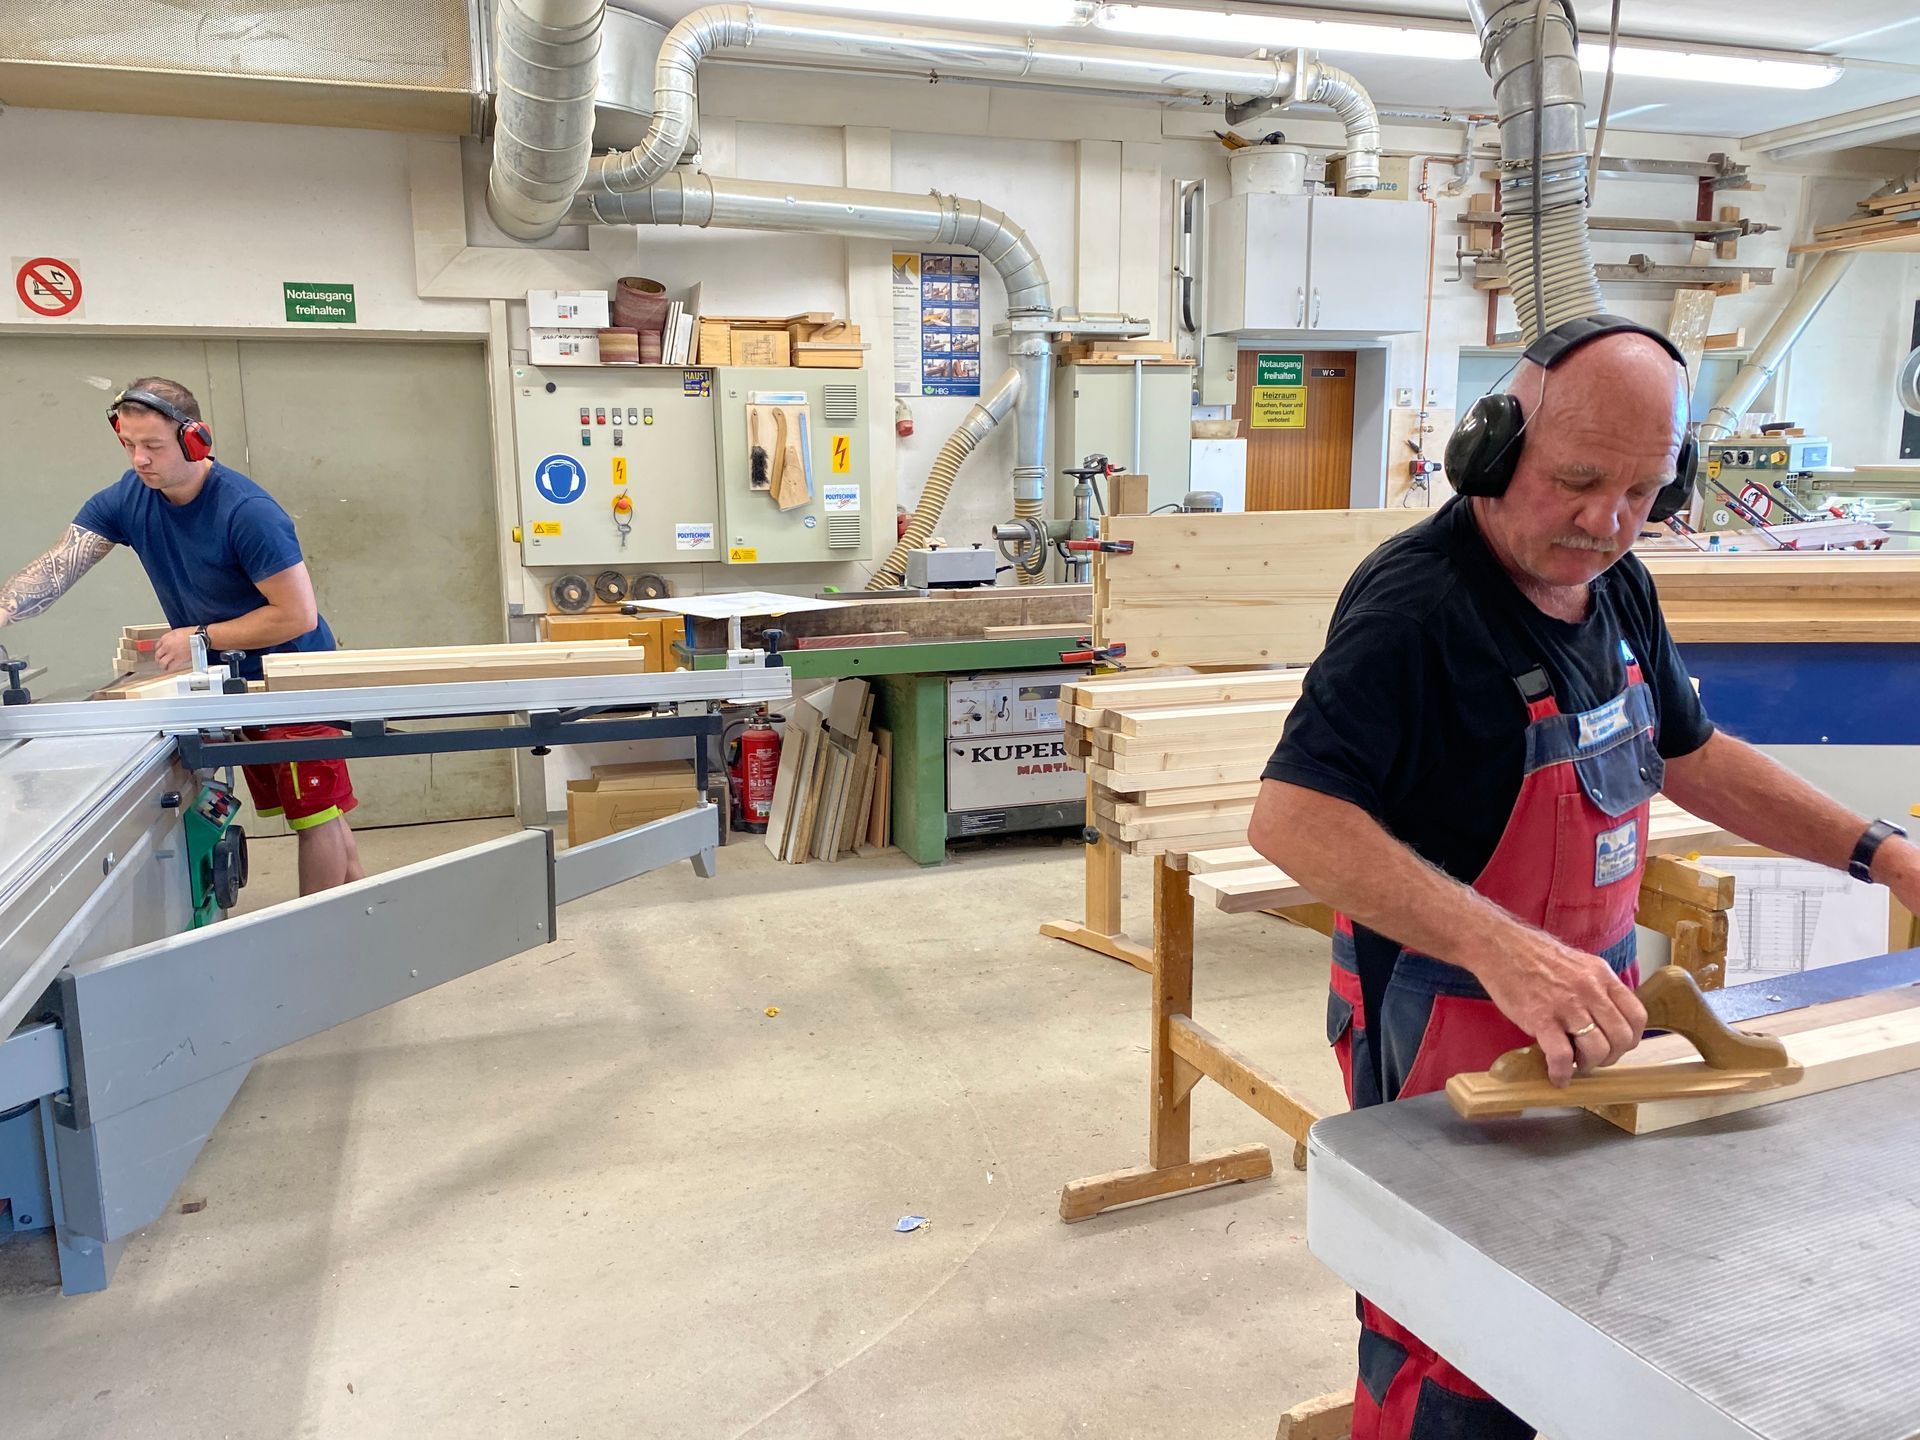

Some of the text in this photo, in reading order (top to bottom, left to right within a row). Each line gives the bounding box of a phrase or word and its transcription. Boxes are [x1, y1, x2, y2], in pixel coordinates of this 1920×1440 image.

[286, 289, 352, 302] Notausgang
[295, 305, 346, 315] freihalten
[1259, 360, 1301, 369] Notausgang
[1264, 372, 1296, 380] freihalten
[1262, 391, 1297, 399] Heizraum
[971, 742, 1067, 763] KUPER
